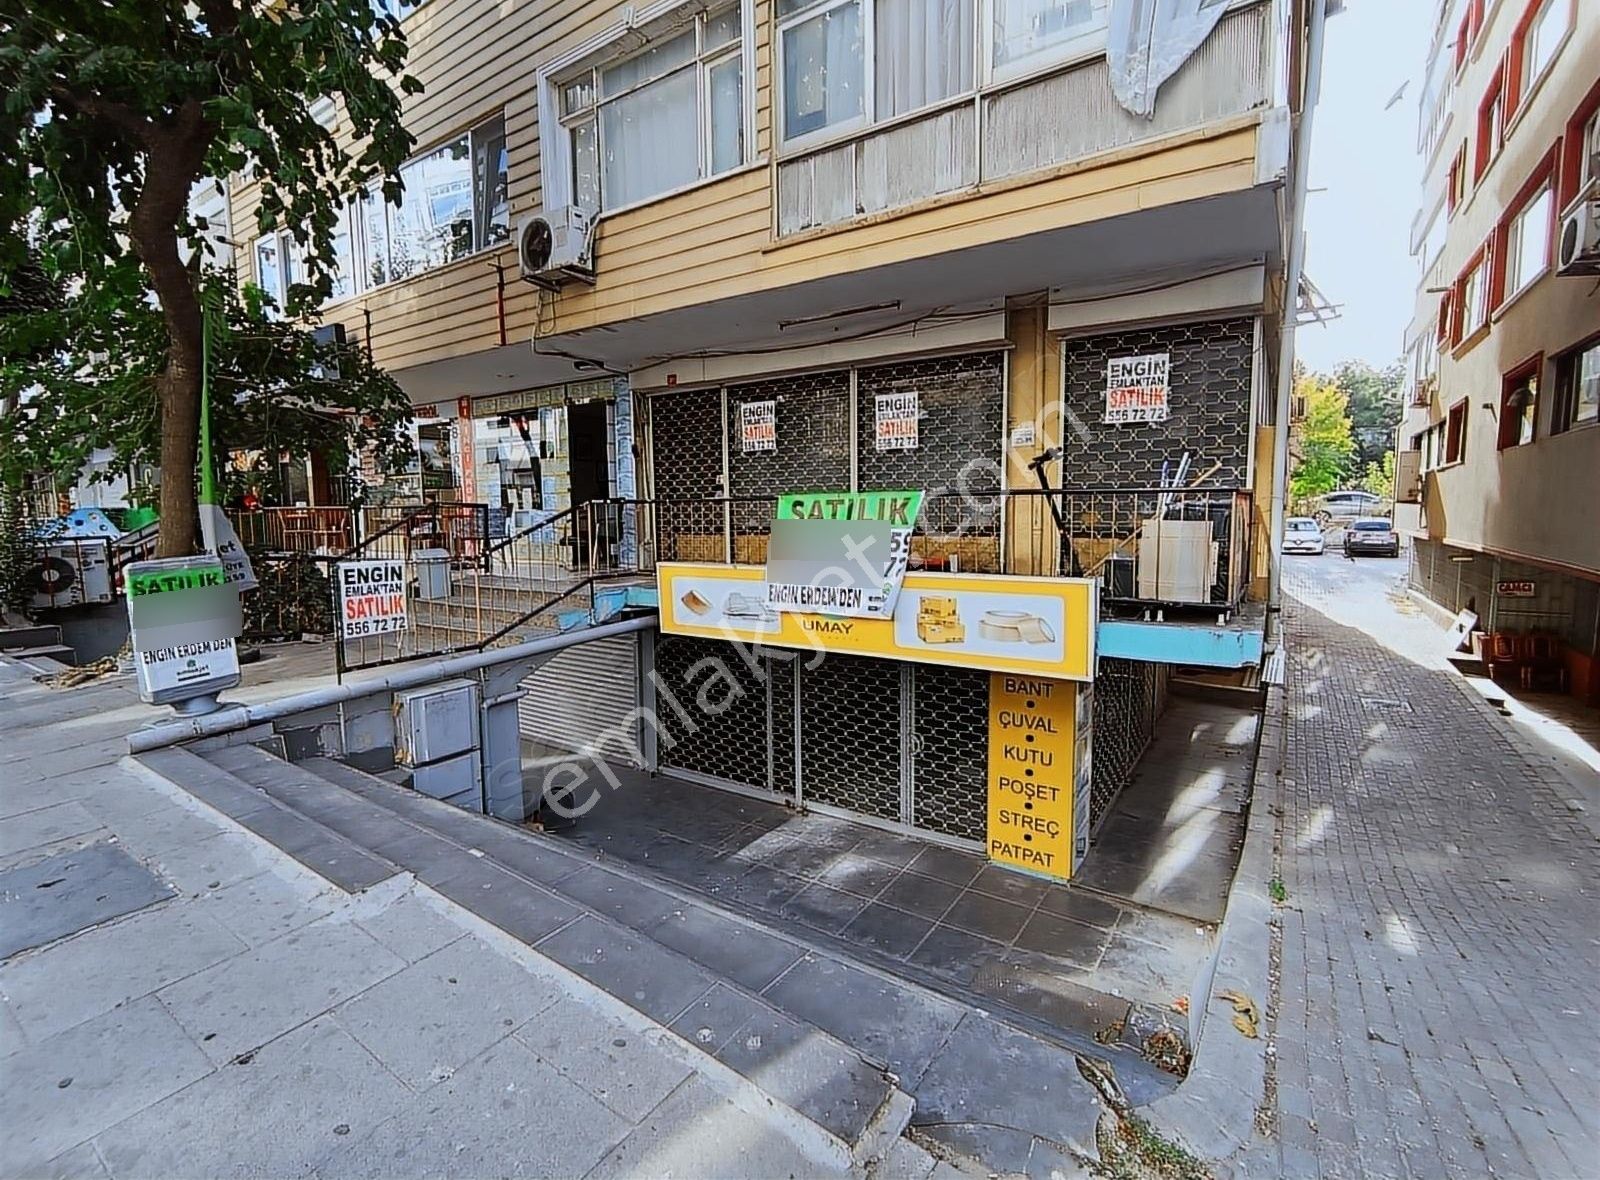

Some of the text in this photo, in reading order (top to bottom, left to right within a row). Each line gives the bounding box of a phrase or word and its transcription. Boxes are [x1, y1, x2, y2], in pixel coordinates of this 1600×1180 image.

[1110, 357, 1166, 378] ENGİN
[1110, 387, 1165, 408] SATILIK
[1132, 409, 1146, 420] 72
[1150, 408, 1164, 419] 72
[791, 497, 912, 525] SATILIK
[343, 562, 403, 586] ENGİN
[345, 583, 403, 598] EMLAK'TAN
[346, 594, 404, 620] SATILIK
[346, 616, 406, 636] 556 72 72
[803, 620, 854, 634] UMAY
[1004, 677, 1054, 699] BANT
[998, 711, 1058, 734] ÇUVAL
[1004, 744, 1053, 767] KUTU
[998, 776, 1061, 802] POŞET
[998, 809, 1060, 839] STREÇ
[991, 839, 1055, 868] PATPAT
